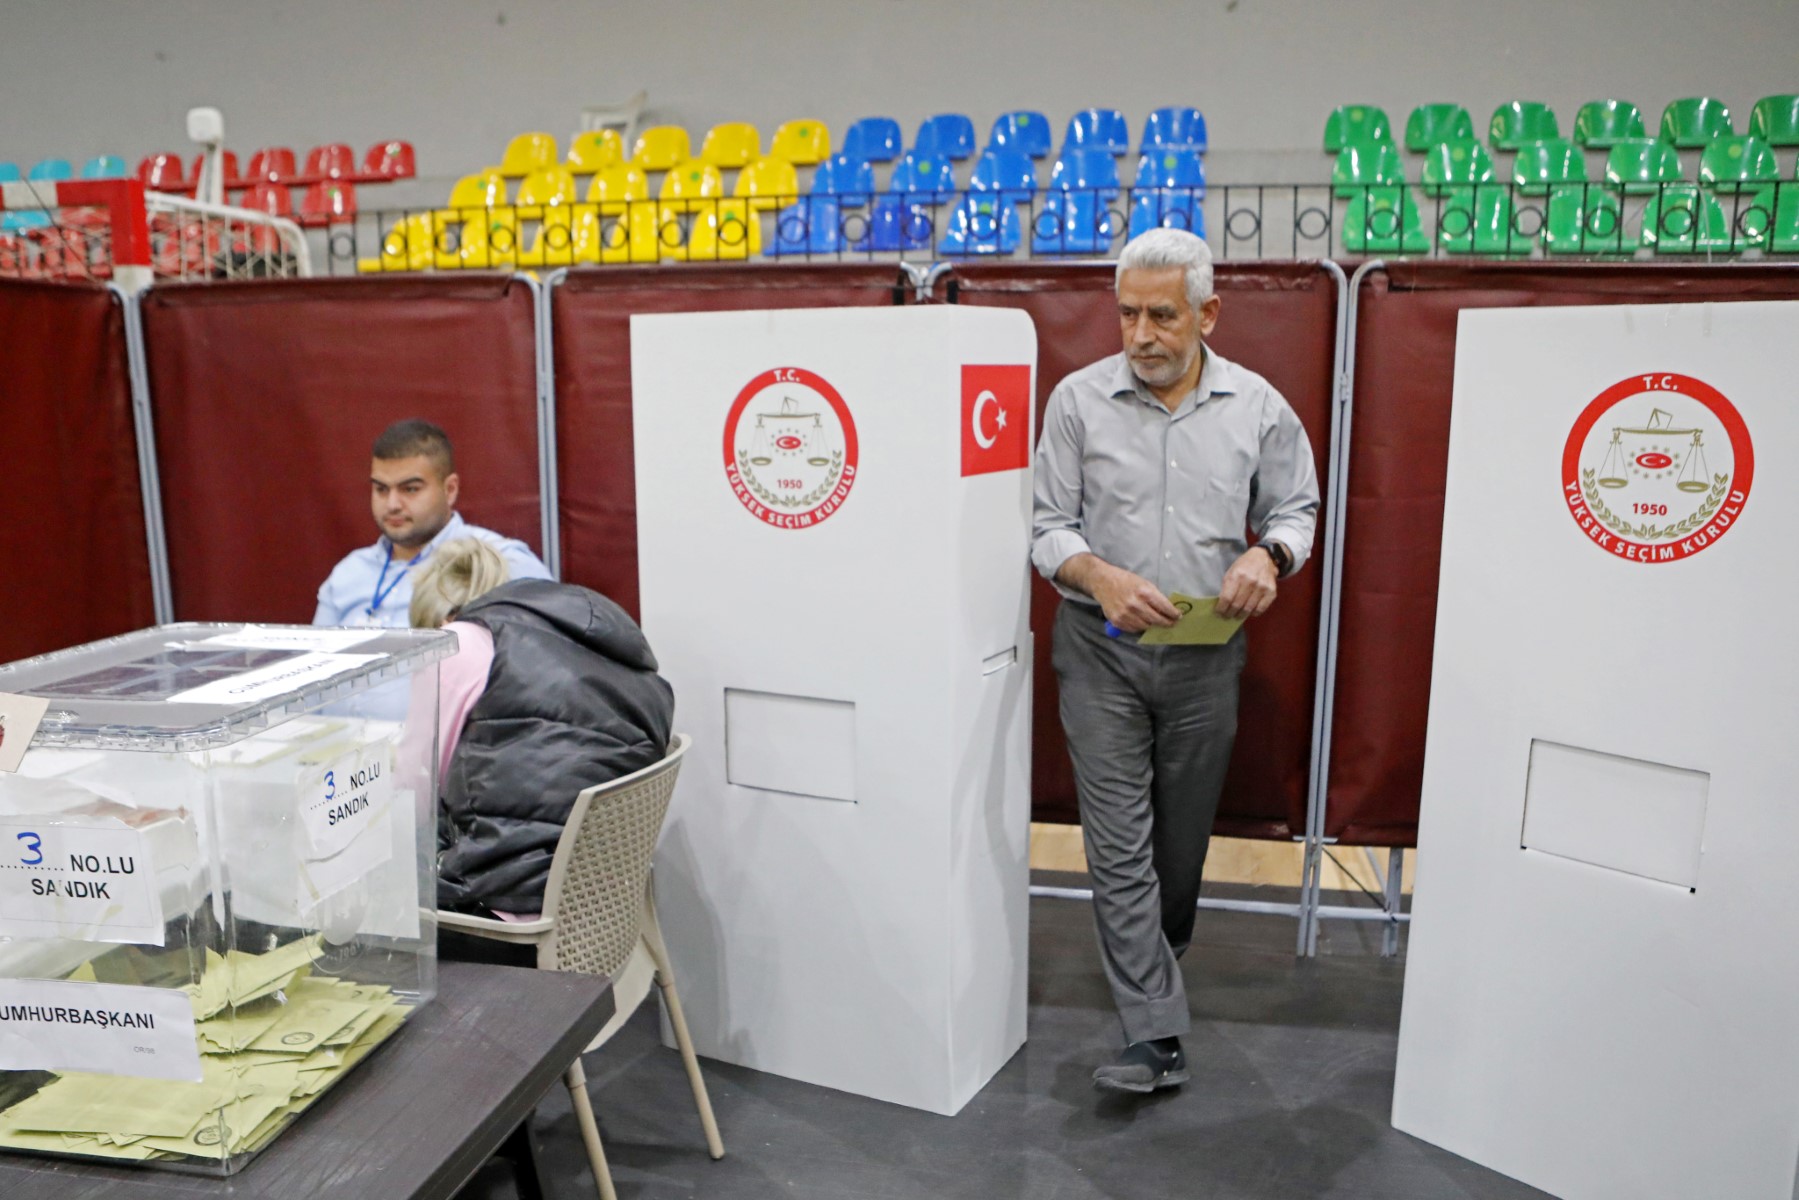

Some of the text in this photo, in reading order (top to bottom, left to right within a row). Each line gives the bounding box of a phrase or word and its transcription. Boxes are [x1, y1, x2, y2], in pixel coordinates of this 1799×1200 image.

[774, 369, 800, 382] T.C.
[1643, 375, 1678, 390] T.C.
[777, 479, 803, 489] 1950
[726, 462, 856, 530] YÜKSEK SEÇİM KURULU
[1632, 502, 1668, 516] 1950
[1565, 481, 1745, 563] YÜKSEK SEÇİM KURULU
[350, 761, 380, 791] NO.LU
[328, 791, 369, 826] SANDIK
[70, 854, 134, 874] NO.LU
[0, 1005, 155, 1029] UMHURBAŞKANI
